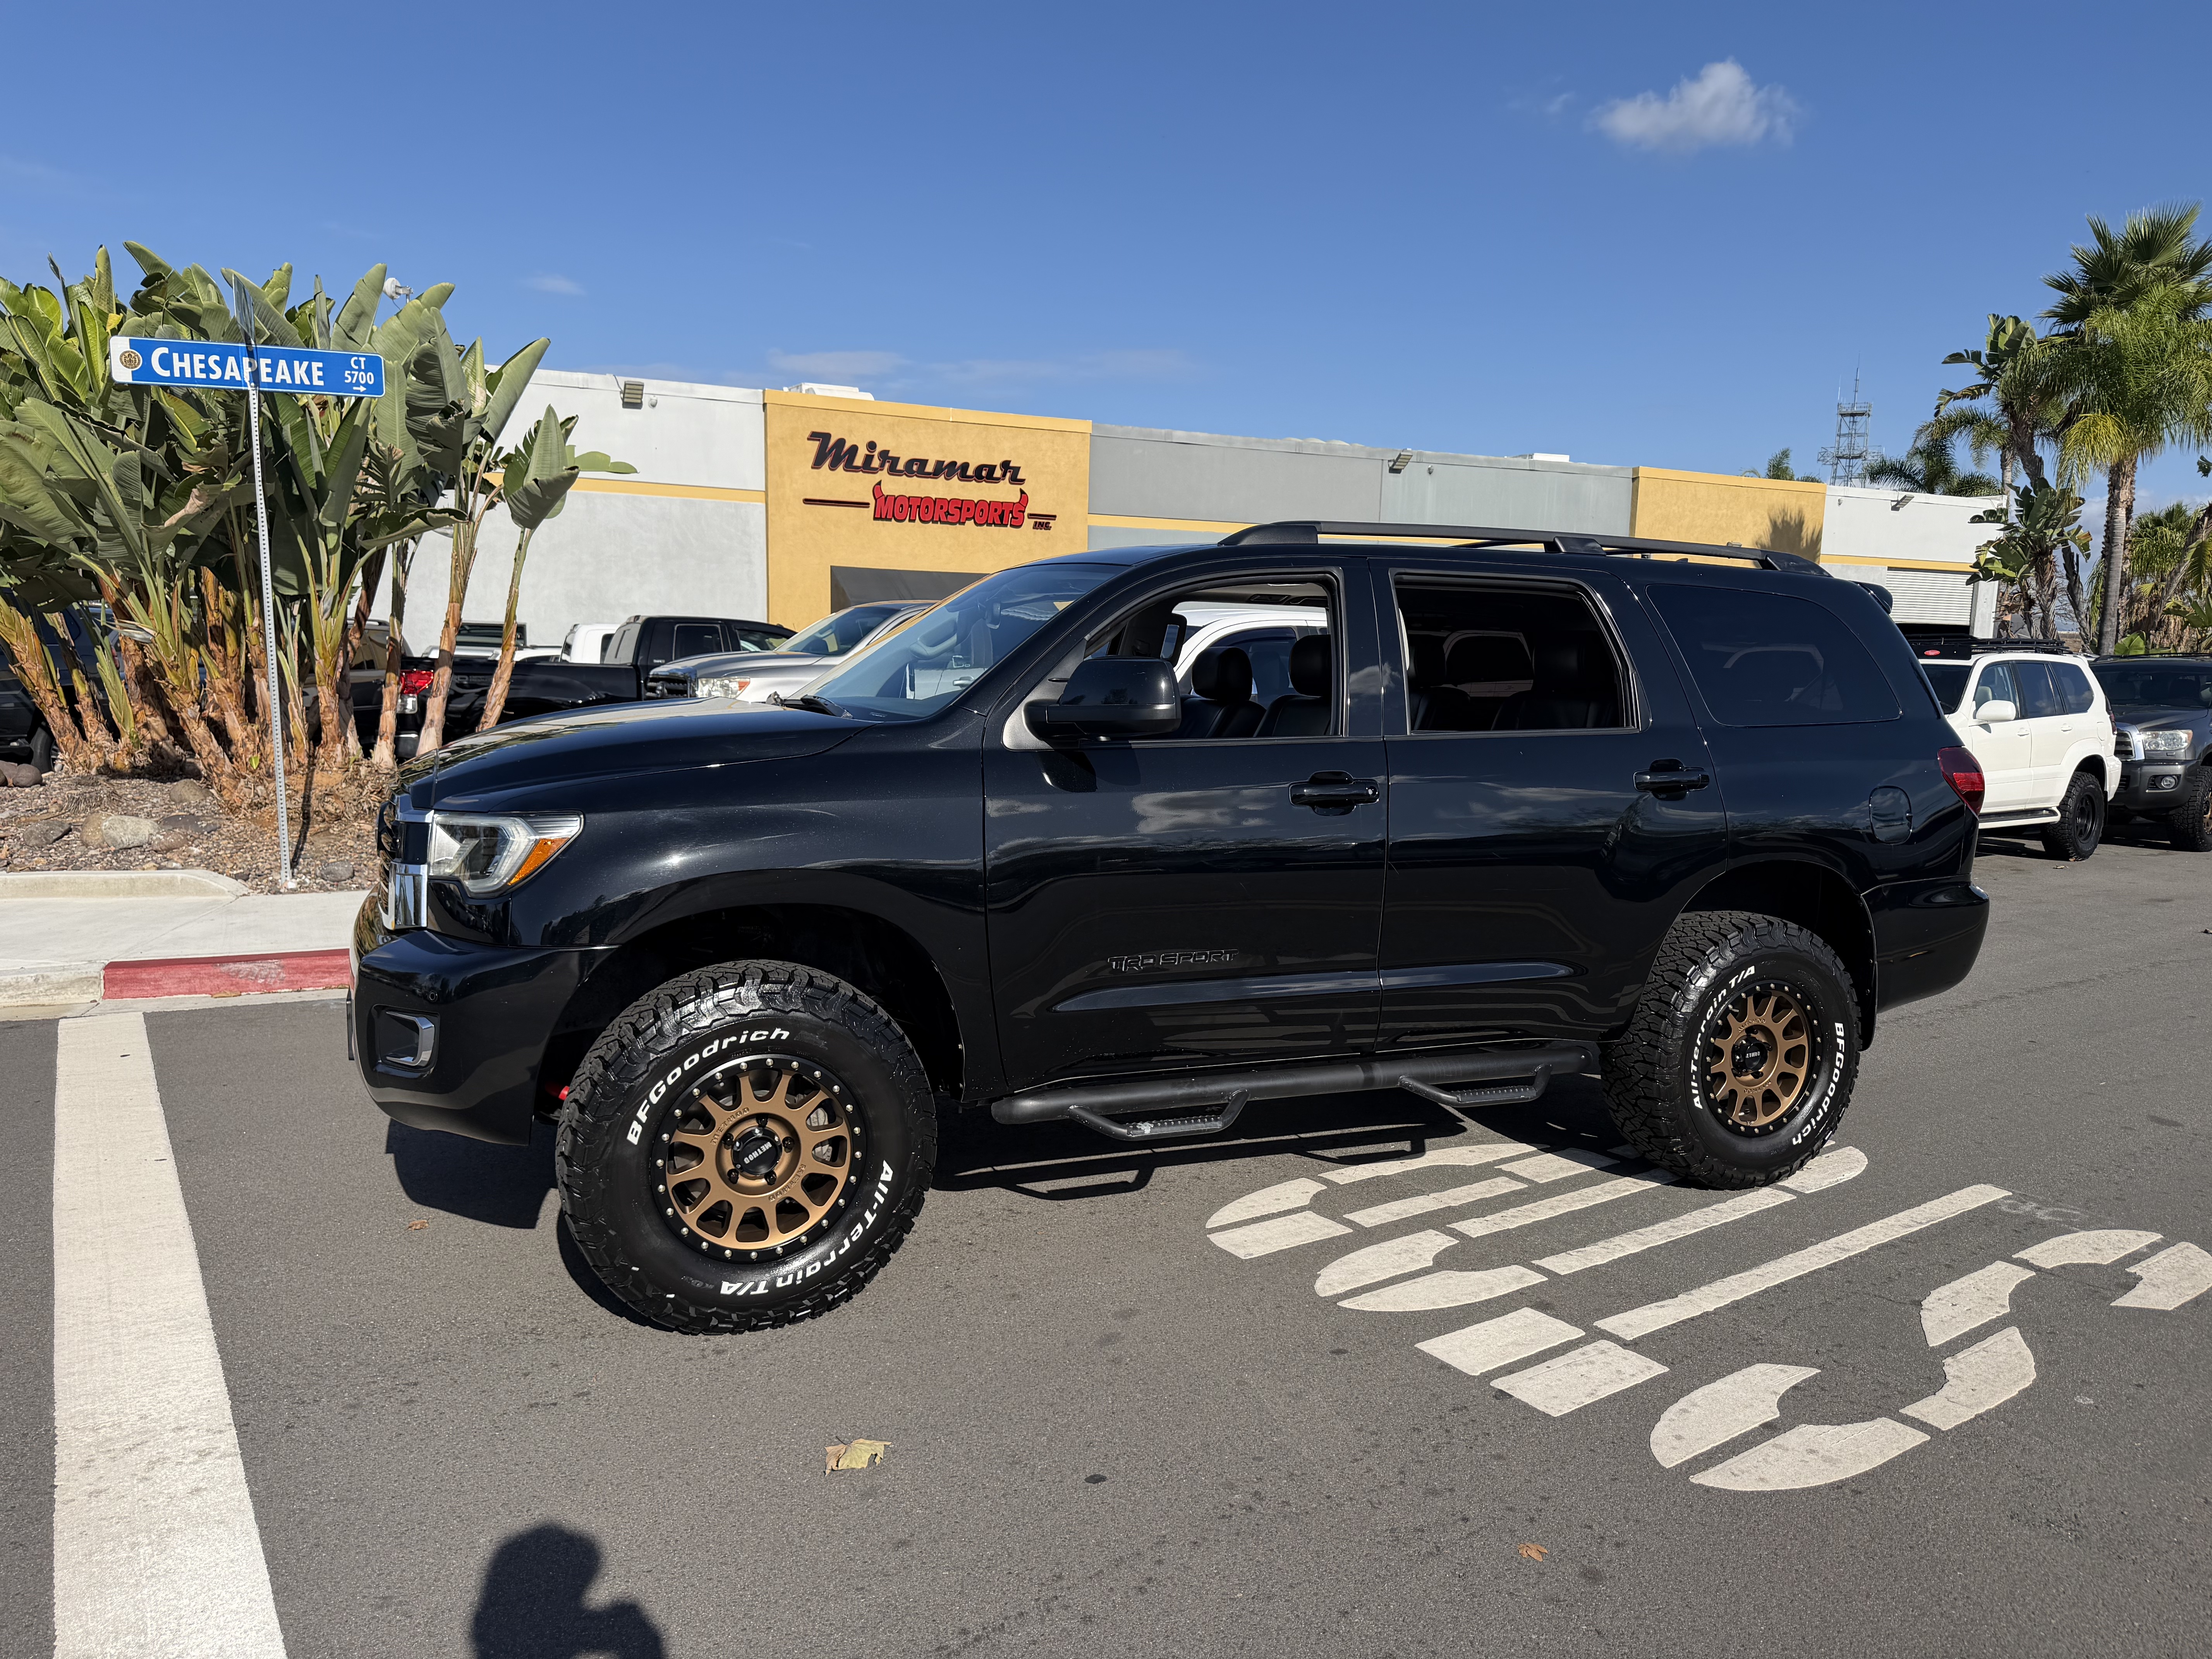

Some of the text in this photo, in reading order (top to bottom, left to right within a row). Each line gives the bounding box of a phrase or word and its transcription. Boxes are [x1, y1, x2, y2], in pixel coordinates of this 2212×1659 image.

[151, 347, 324, 386] CHESAPEAKE
[350, 357, 366, 369] CT
[345, 371, 374, 385] 5700
[807, 431, 1026, 485] Miramar
[873, 494, 1025, 528] MOTORSPORTS
[1033, 521, 1052, 531] INC.
[1108, 949, 1239, 971] TRD SPORT
[626, 1027, 790, 1145] BFGoodrich
[1792, 1022, 1845, 1146] BFGoodrich
[744, 1142, 772, 1164] METHOD
